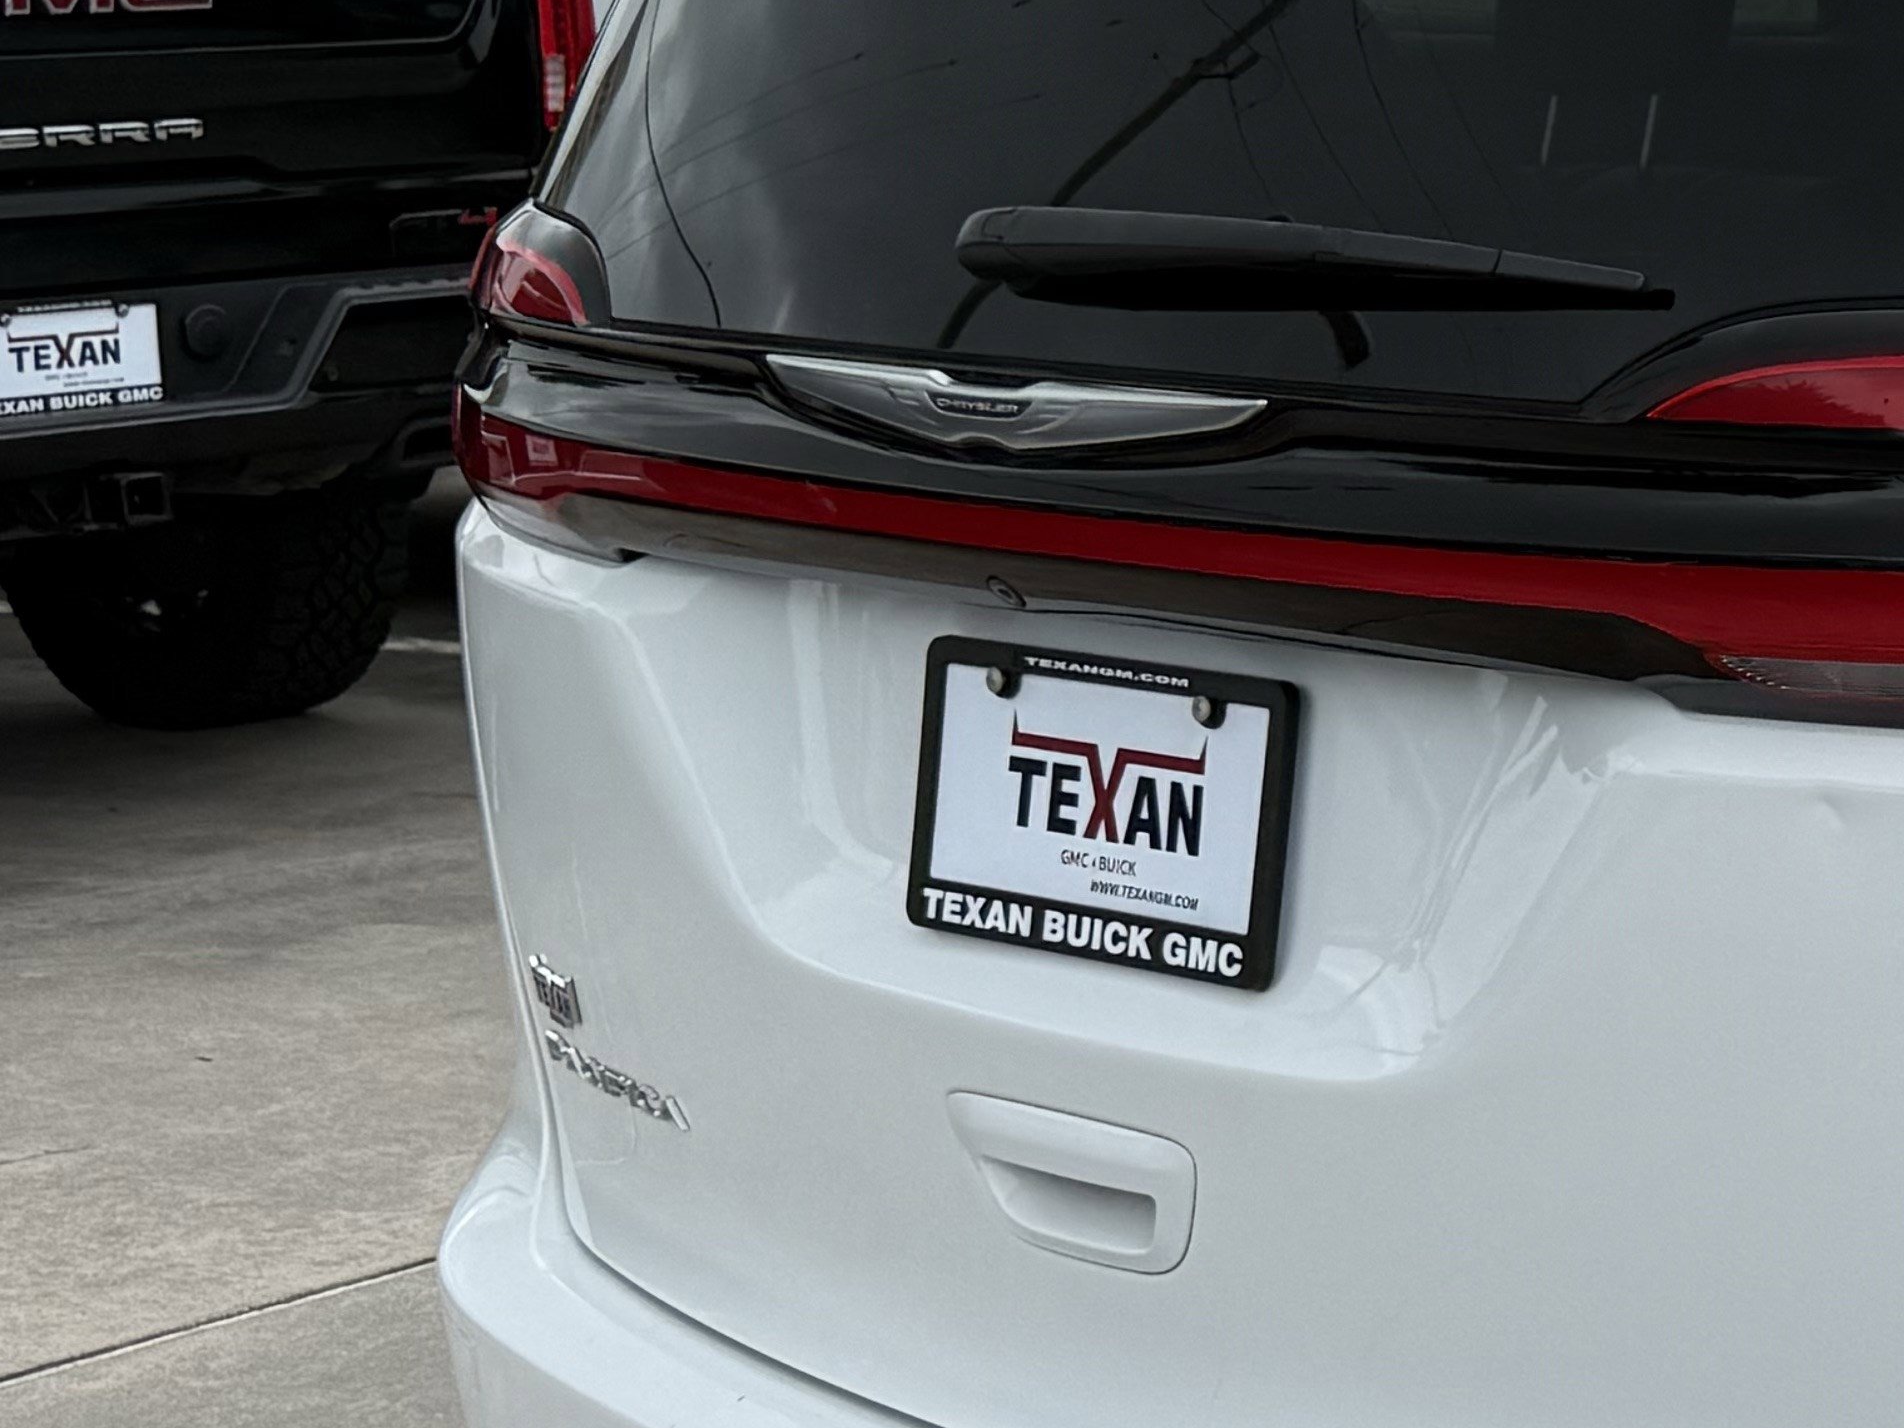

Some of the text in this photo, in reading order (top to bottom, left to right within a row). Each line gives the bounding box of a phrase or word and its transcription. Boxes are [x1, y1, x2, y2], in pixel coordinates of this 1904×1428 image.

[8, 332, 121, 373] TEXAN
[0, 386, 164, 416] XAN BUICK GMC
[936, 397, 1019, 414] CHRYSLER
[1024, 656, 1189, 688] TEXANGM.COM
[1008, 744, 1204, 857] TEXAN
[1060, 848, 1137, 877] GMC BUICK
[923, 887, 1244, 978] TEXAN BUICK GMC
